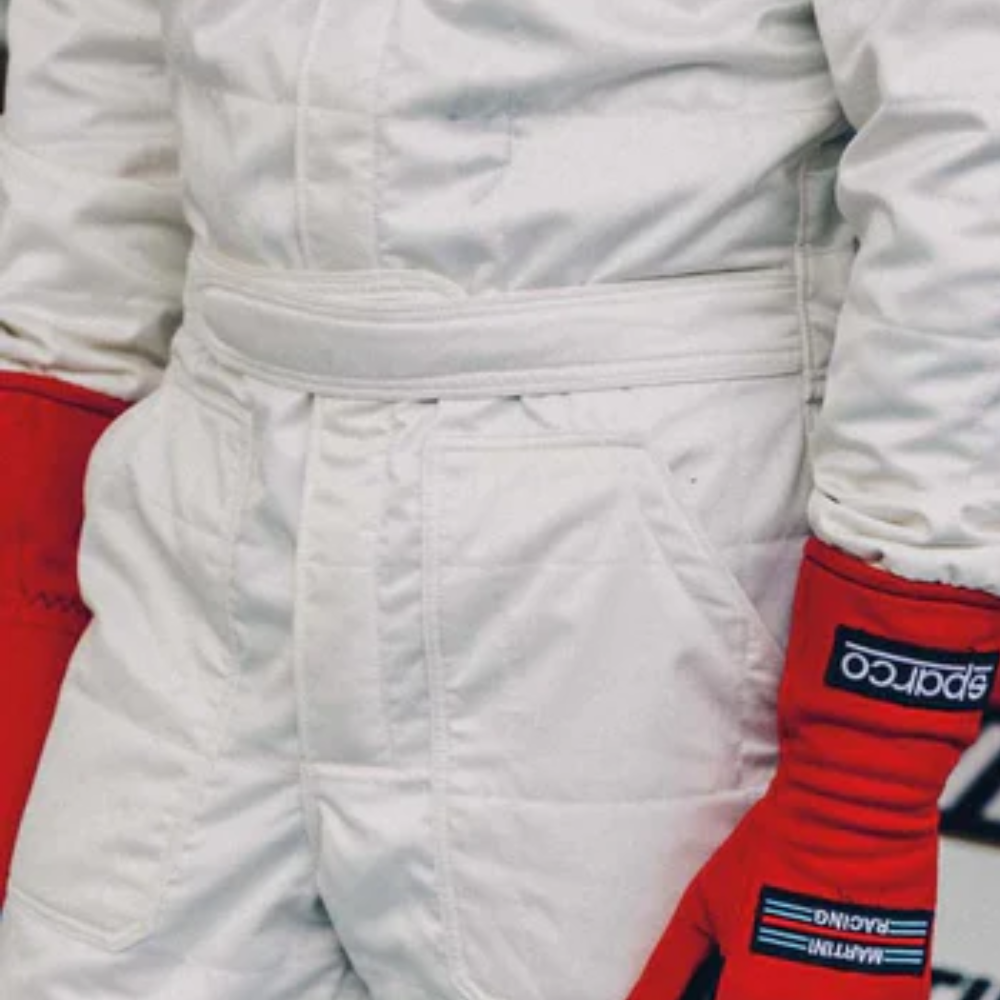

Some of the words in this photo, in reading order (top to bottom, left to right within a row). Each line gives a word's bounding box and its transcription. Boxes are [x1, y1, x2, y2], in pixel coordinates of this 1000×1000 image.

[840, 640, 994, 702] sparco
[813, 908, 892, 937] RACING
[806, 937, 886, 966] MARTINI
